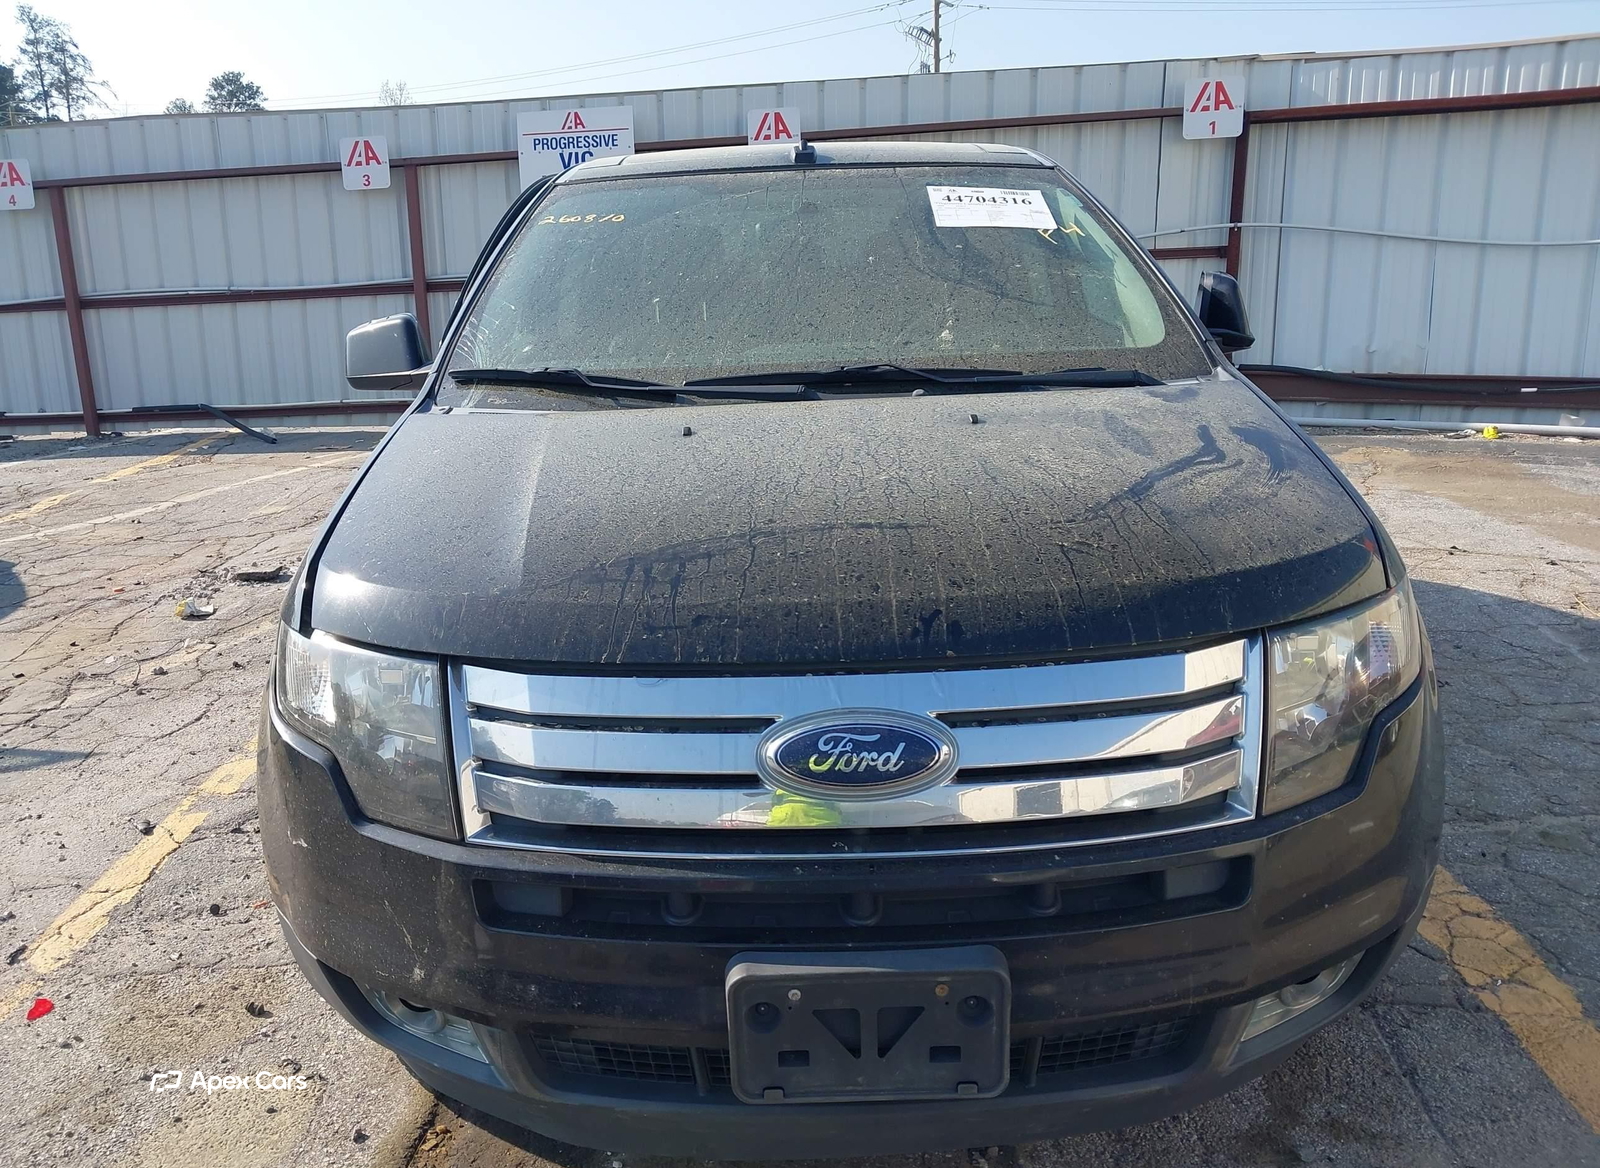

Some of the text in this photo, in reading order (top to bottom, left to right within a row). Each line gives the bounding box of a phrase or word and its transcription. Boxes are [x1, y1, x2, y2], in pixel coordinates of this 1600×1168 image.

[1208, 120, 1216, 135] 1
[532, 133, 619, 151] PROGRESSIVE
[362, 173, 371, 187] 3
[8, 194, 17, 207] 4
[941, 193, 1033, 206] 44704316
[808, 732, 906, 773] Ford
